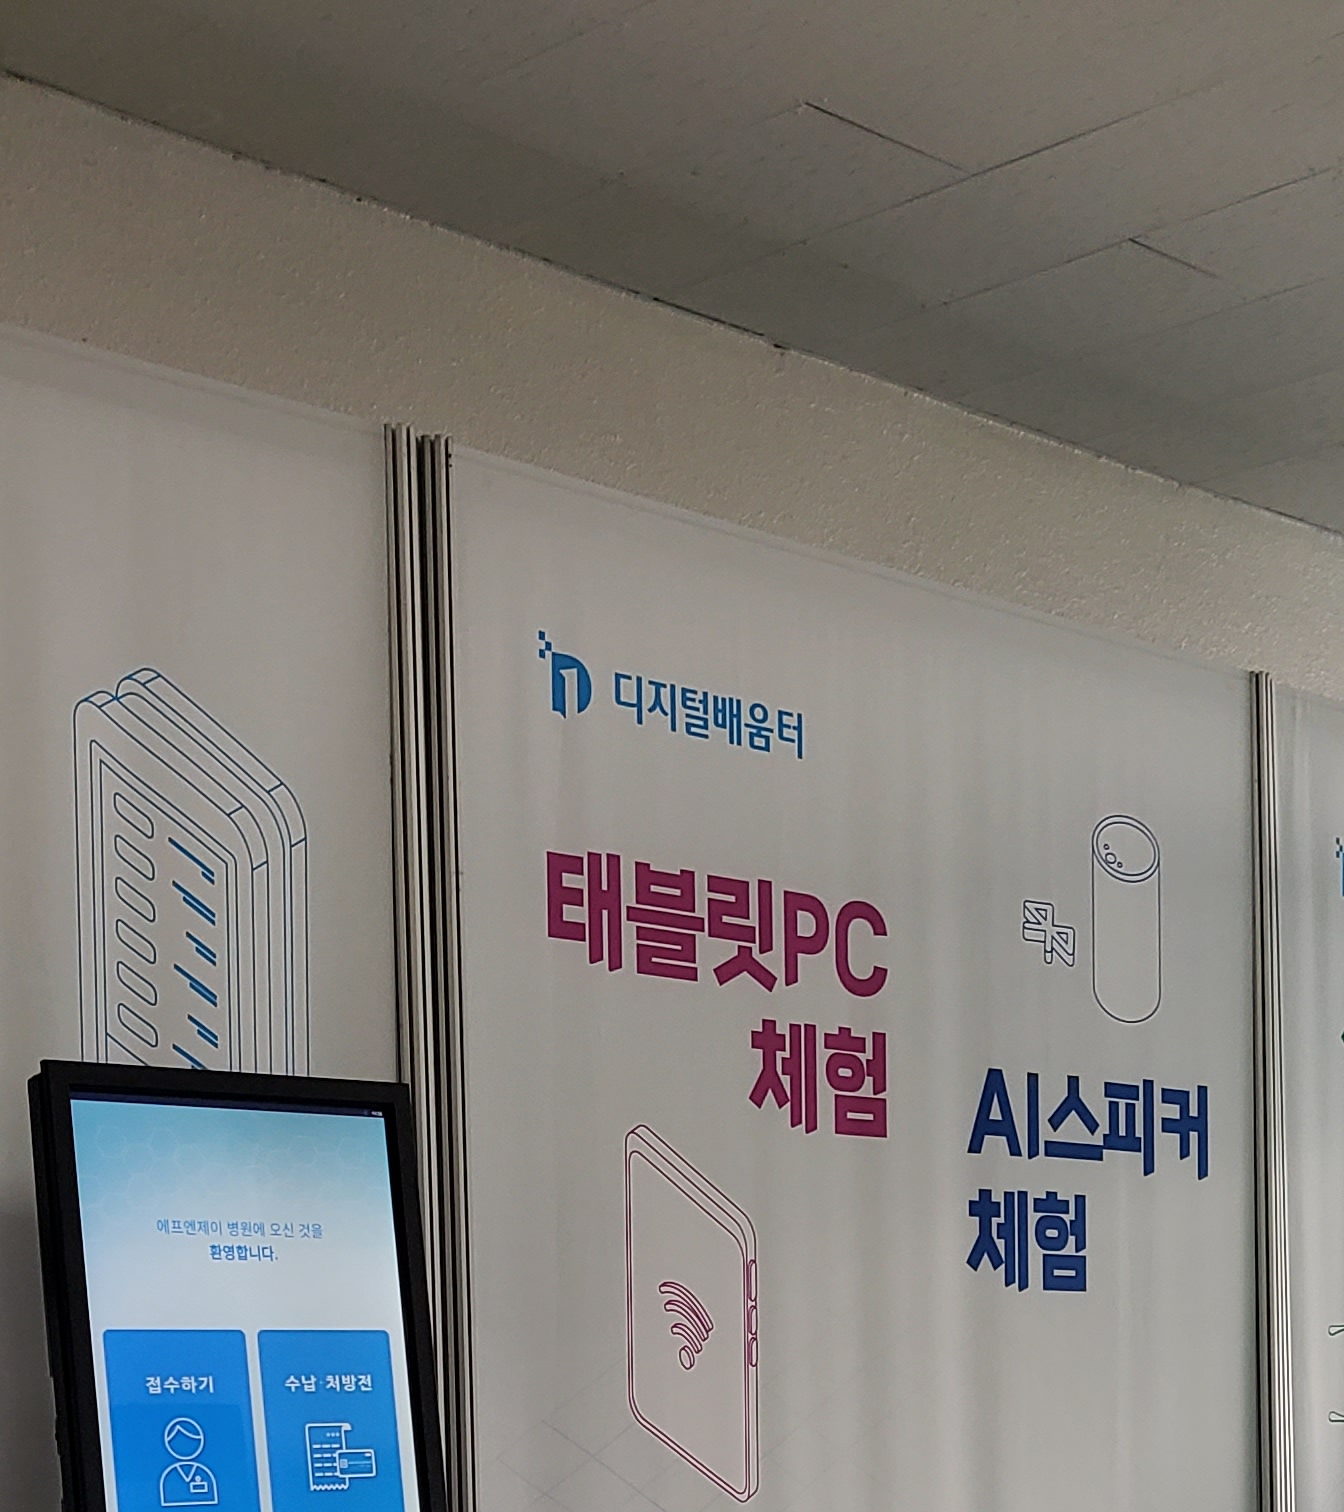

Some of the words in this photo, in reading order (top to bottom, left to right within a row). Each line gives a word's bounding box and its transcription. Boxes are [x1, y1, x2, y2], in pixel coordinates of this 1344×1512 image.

[615, 671, 804, 759] 디지털배움터
[546, 851, 888, 998] 태블릿PC
[748, 1018, 888, 1138] 체험
[967, 1067, 1209, 1180] AI스피커
[157, 1219, 222, 1236] 에프엔제이
[227, 1221, 266, 1237] 병원에
[270, 1222, 294, 1238] 오신
[299, 1223, 323, 1239] 것을
[210, 1244, 278, 1262] 환영합니다.
[966, 1189, 1087, 1292] 체험
[146, 1376, 214, 1394] 접수하기
